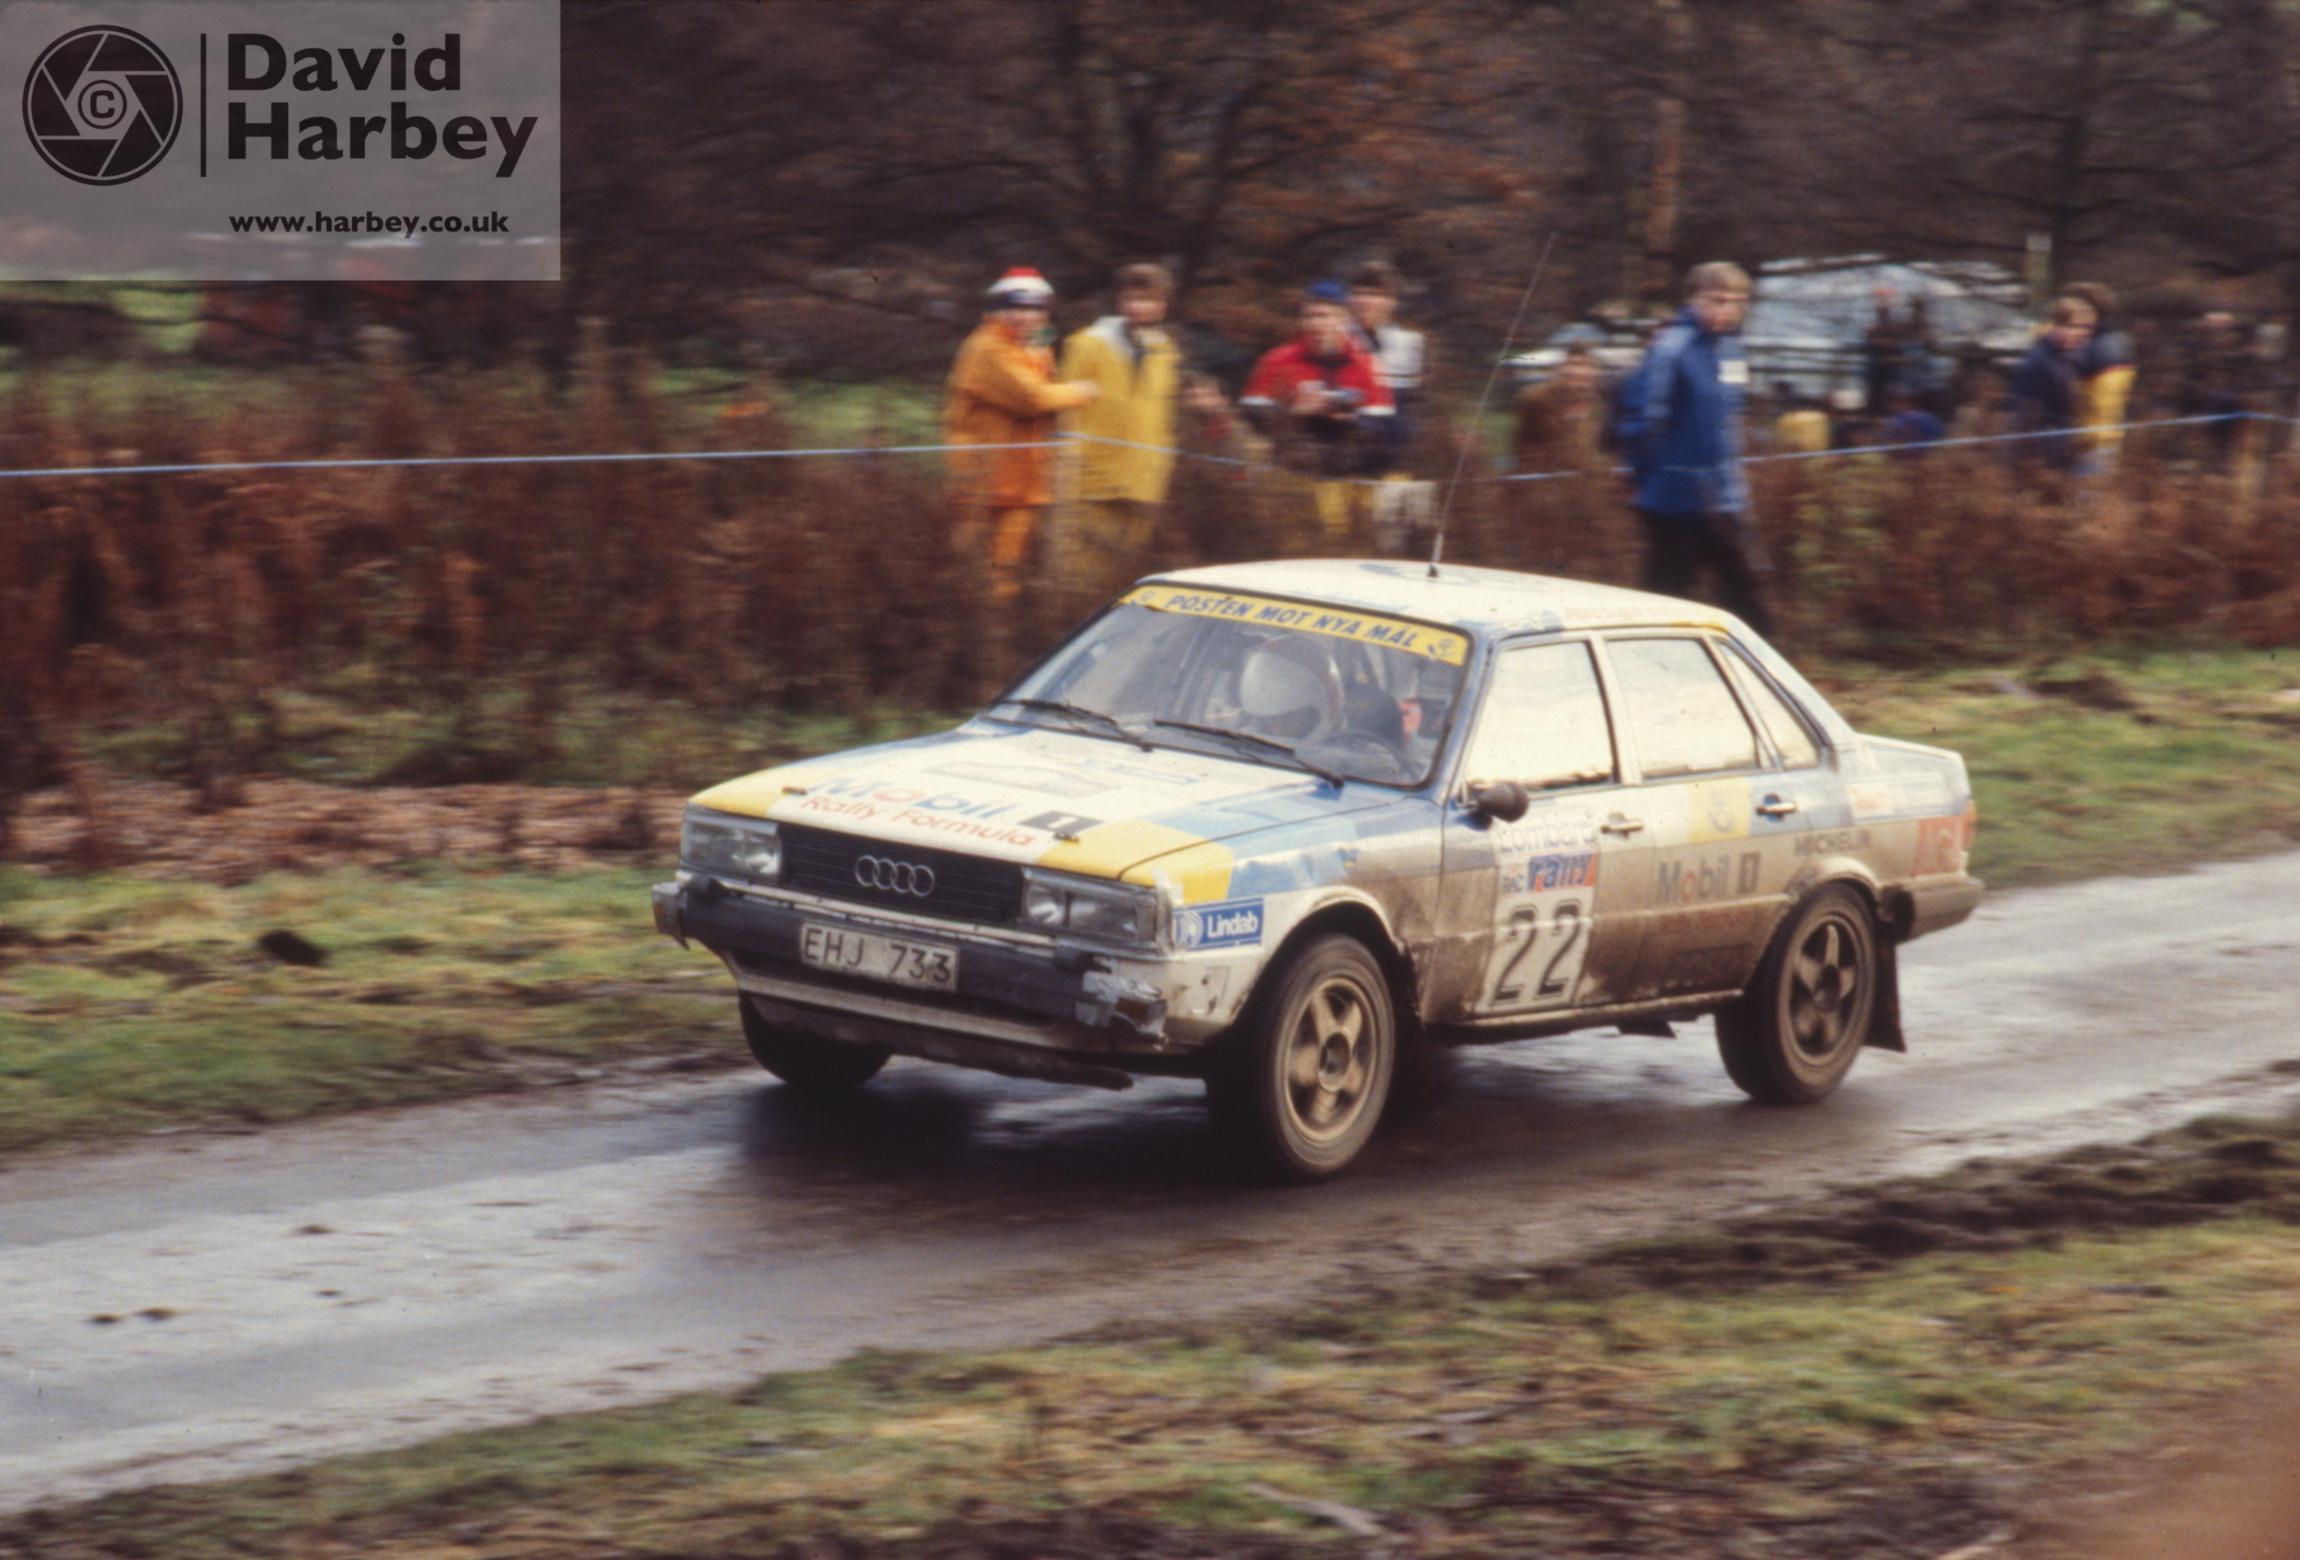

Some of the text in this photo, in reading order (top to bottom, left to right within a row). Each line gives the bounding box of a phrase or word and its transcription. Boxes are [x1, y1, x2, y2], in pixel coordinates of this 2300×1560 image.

[1163, 595, 1254, 617] POSTEN
[1254, 604, 1313, 626] MOT
[1312, 614, 1363, 635] NYA
[806, 777, 1021, 819] Mobil
[800, 796, 1037, 848] Rally Formula
[1528, 854, 1595, 891] rally
[1654, 853, 1732, 904] Mobil
[1206, 909, 1259, 938] Lindab
[804, 928, 951, 984] EHJ 733
[1490, 899, 1582, 1003] 22
